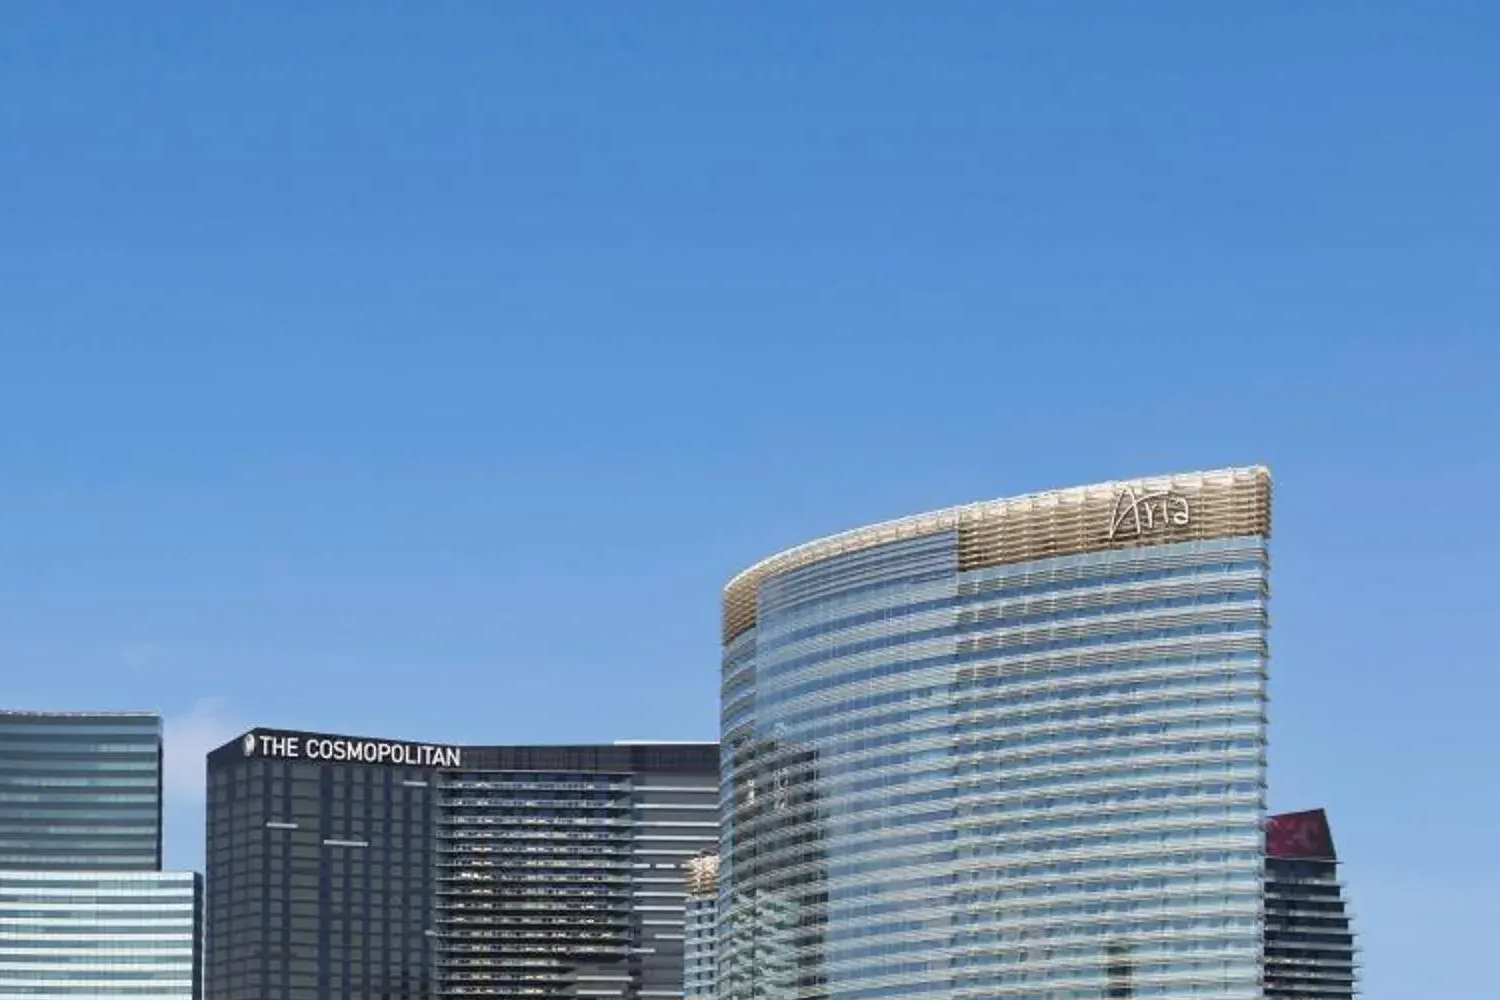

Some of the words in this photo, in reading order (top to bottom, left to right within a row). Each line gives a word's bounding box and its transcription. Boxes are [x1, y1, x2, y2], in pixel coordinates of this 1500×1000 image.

[1109, 486, 1189, 540] Aria
[259, 735, 299, 757] THE
[306, 739, 461, 767] COSMOPOLITAN
